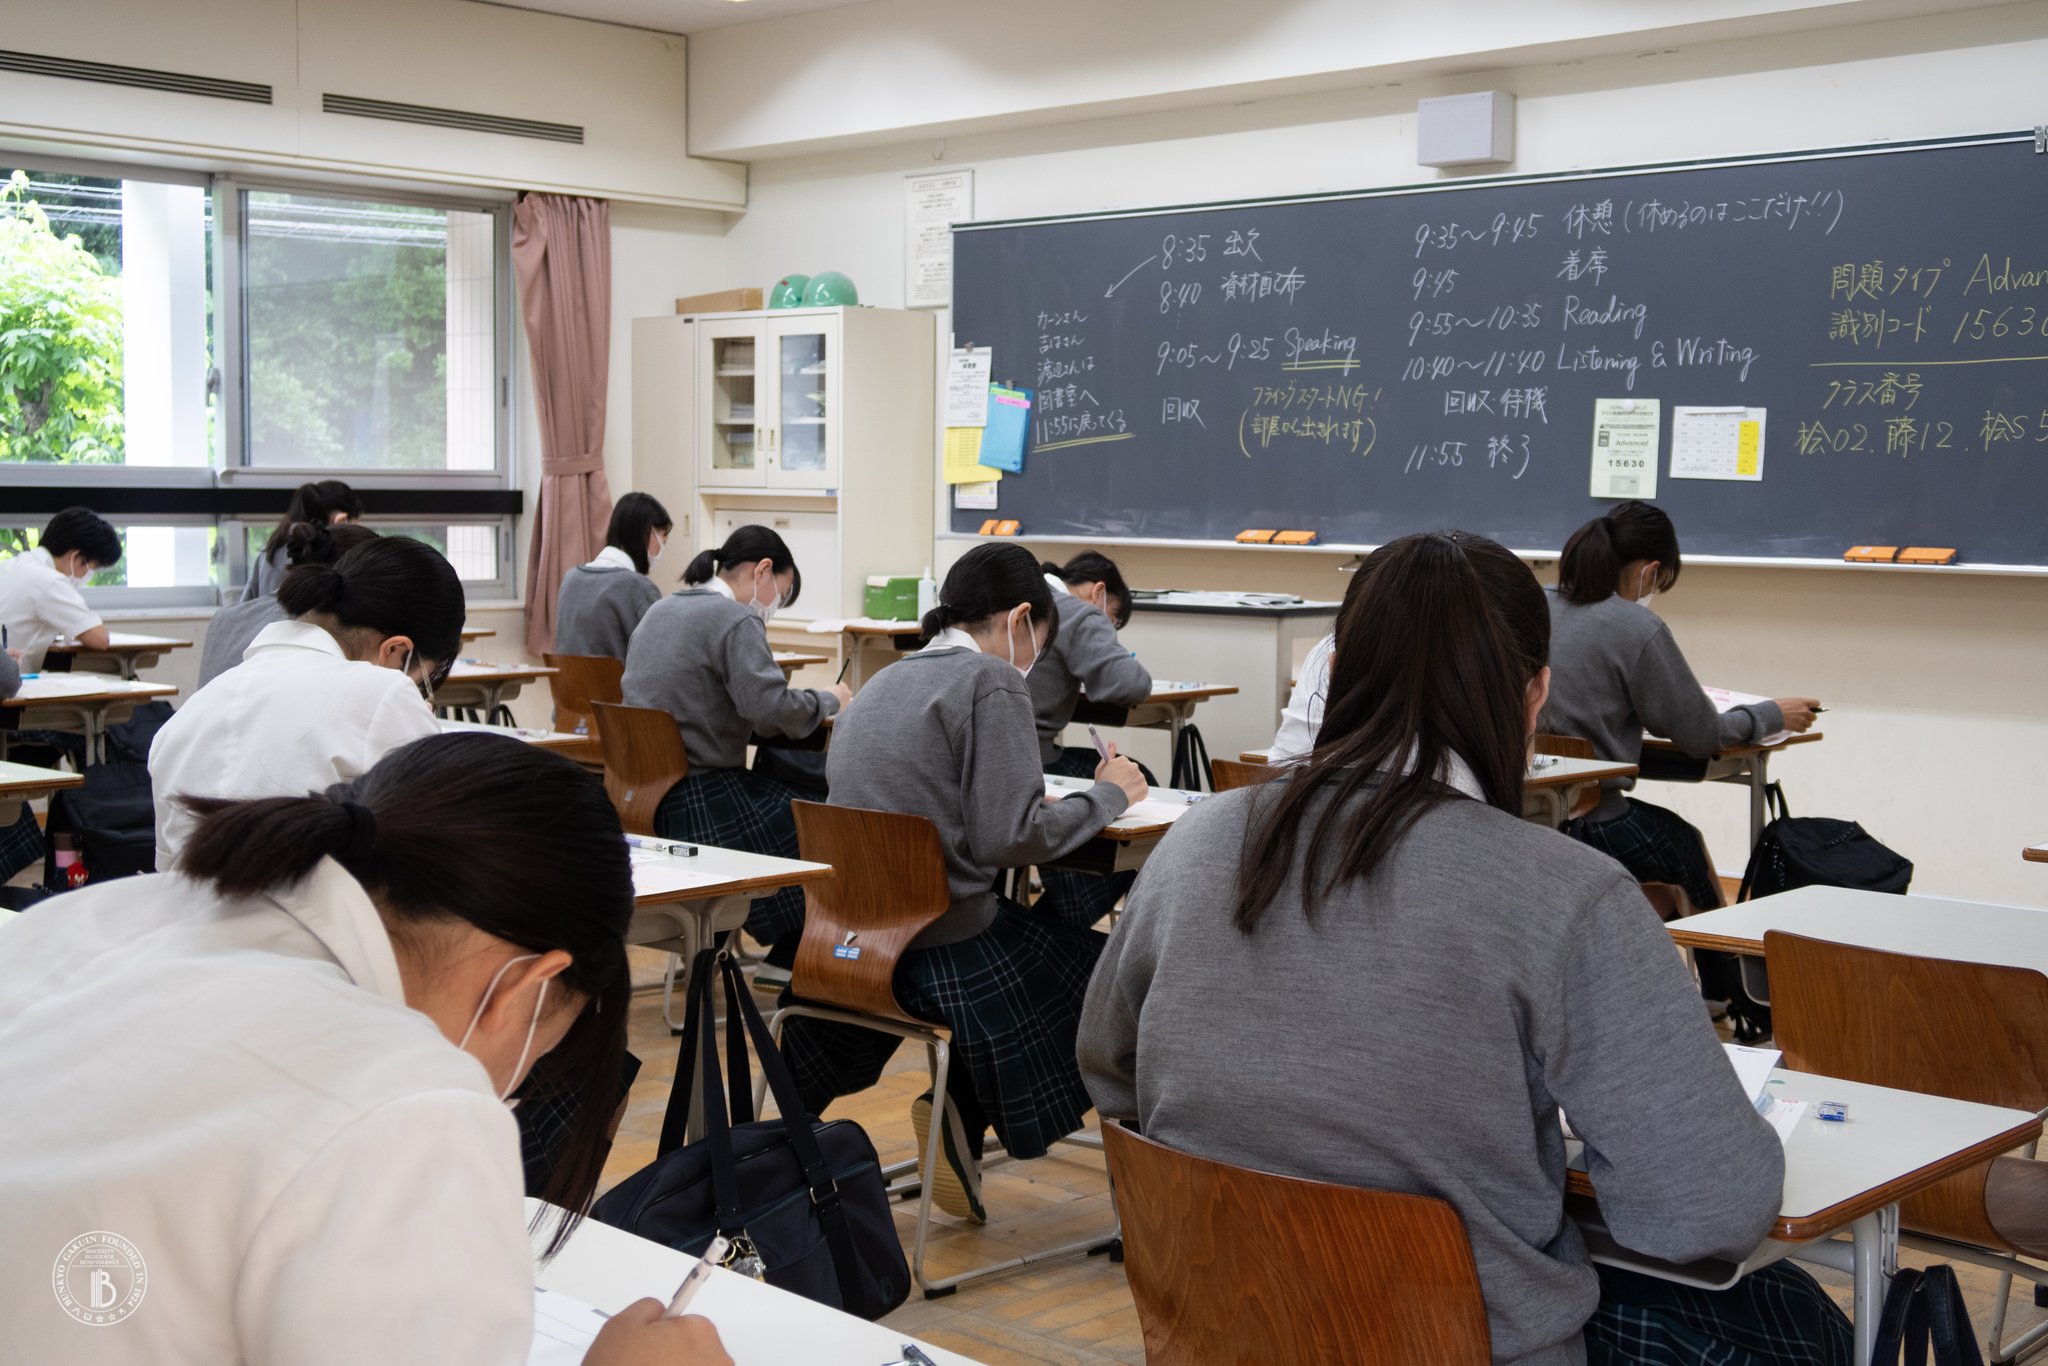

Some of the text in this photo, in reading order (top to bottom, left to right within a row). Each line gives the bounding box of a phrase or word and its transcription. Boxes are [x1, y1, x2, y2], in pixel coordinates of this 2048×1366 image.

[1161, 234, 1212, 271] 8:35
[1412, 245, 1609, 302] 9:45 着席
[1159, 265, 1307, 315] 8:40 資材配布
[1562, 294, 1648, 340] Reading
[1828, 304, 1932, 350] 識別コード
[1284, 326, 1358, 378] Speaking
[1556, 342, 1643, 391] Listening
[1676, 336, 1761, 383] Writing
[1161, 396, 1207, 429] 回収
[1822, 371, 1924, 411] クラス番号
[1404, 433, 1531, 480] 11:55 終了
[1608, 459, 1645, 468] 15630
[1615, 439, 1649, 447] Advanced
